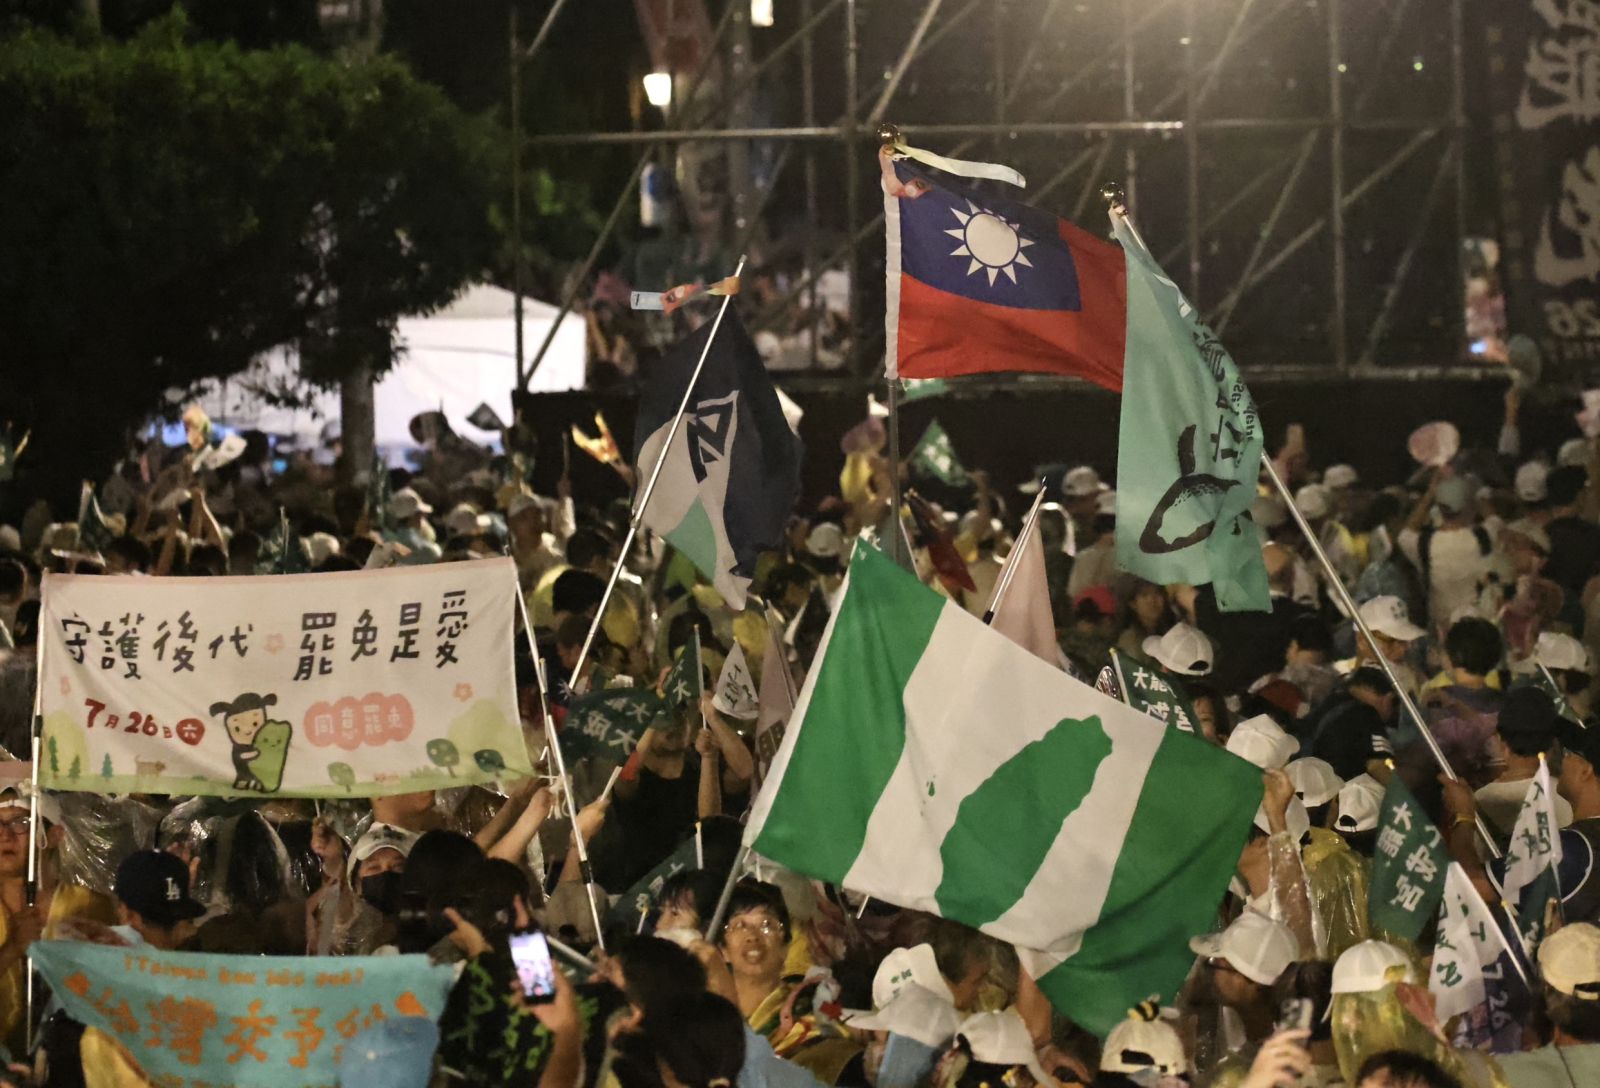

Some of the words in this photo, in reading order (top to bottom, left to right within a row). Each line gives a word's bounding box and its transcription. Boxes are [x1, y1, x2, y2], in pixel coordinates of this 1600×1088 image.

[61, 610, 254, 681] 守護後代
[293, 589, 470, 682] 罷免是愛
